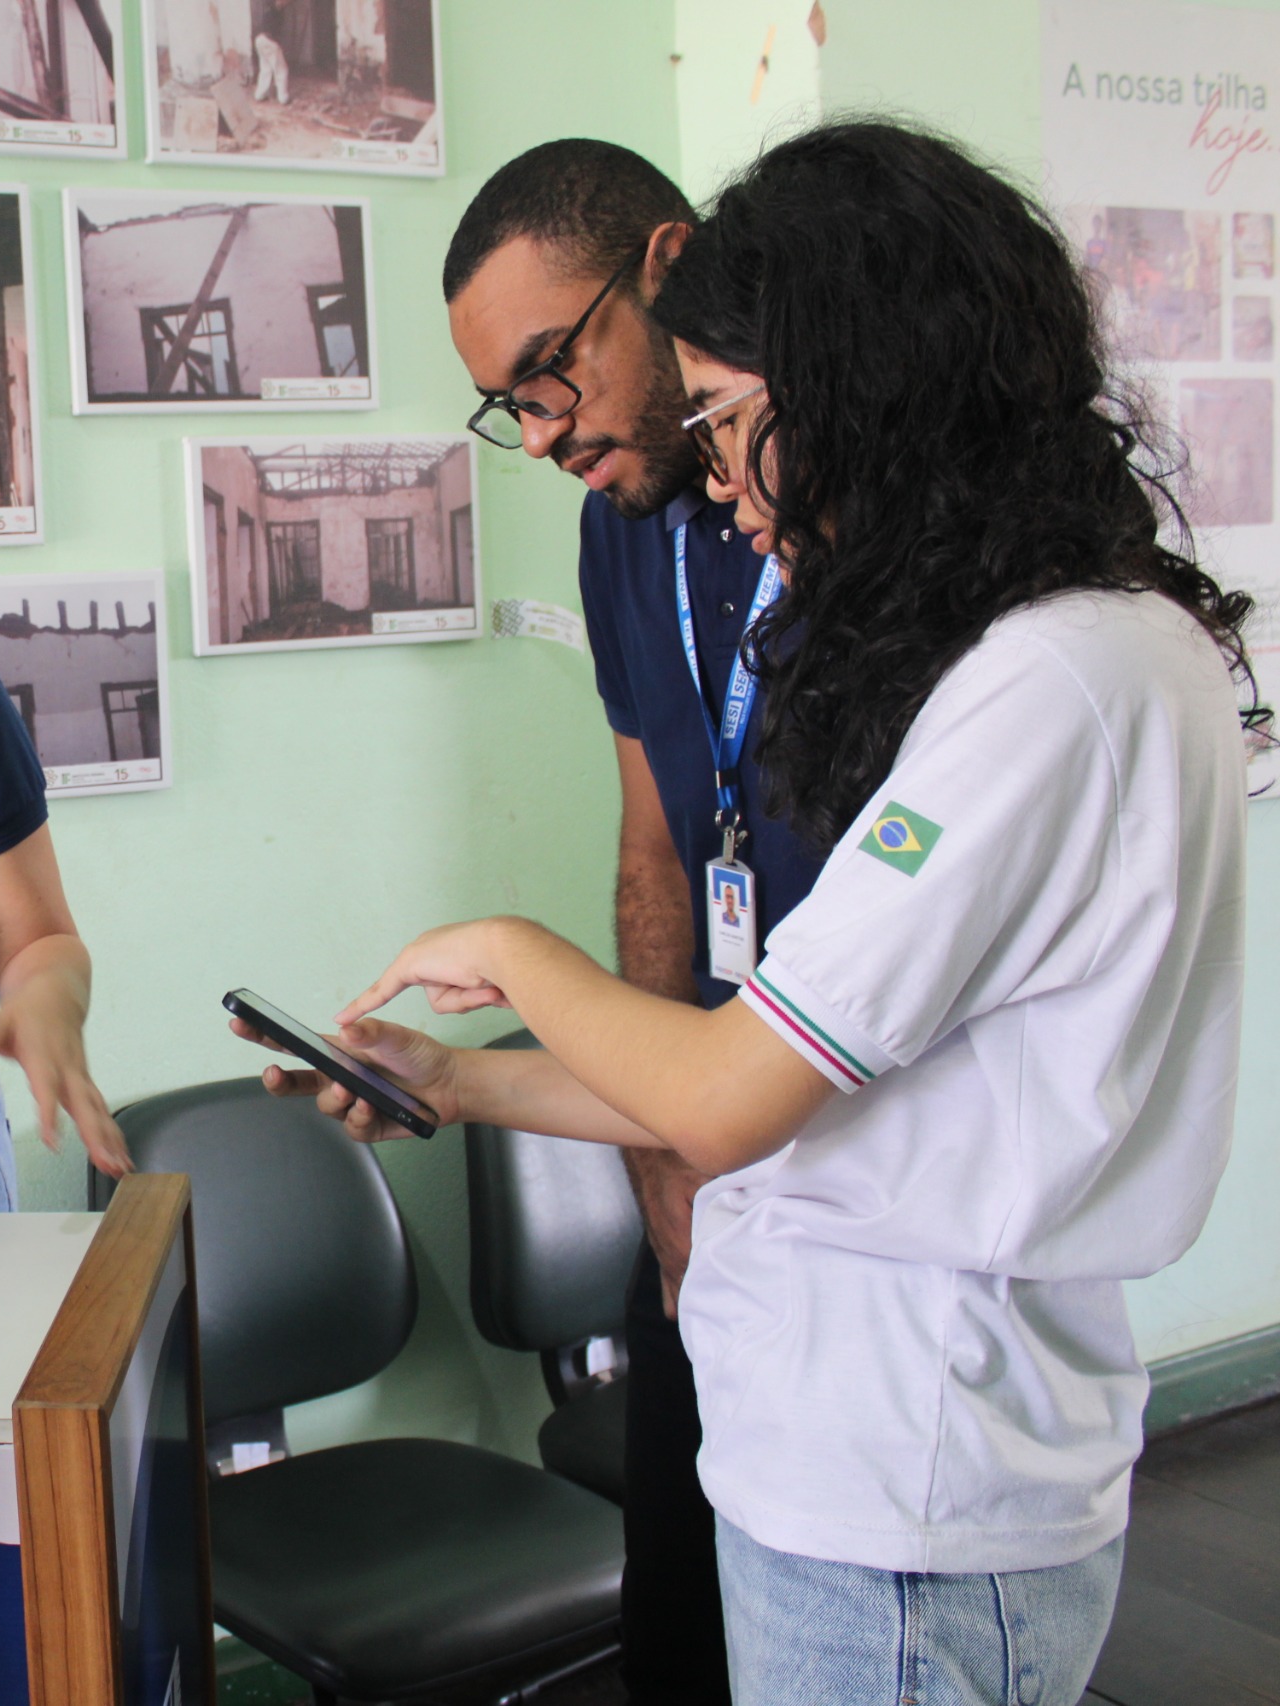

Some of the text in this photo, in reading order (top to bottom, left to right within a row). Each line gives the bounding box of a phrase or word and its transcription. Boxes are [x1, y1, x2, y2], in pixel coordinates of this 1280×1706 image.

[1062, 61, 1267, 110] A nossa trilha
[725, 703, 741, 735] SESI
[113, 767, 129, 781] 15
